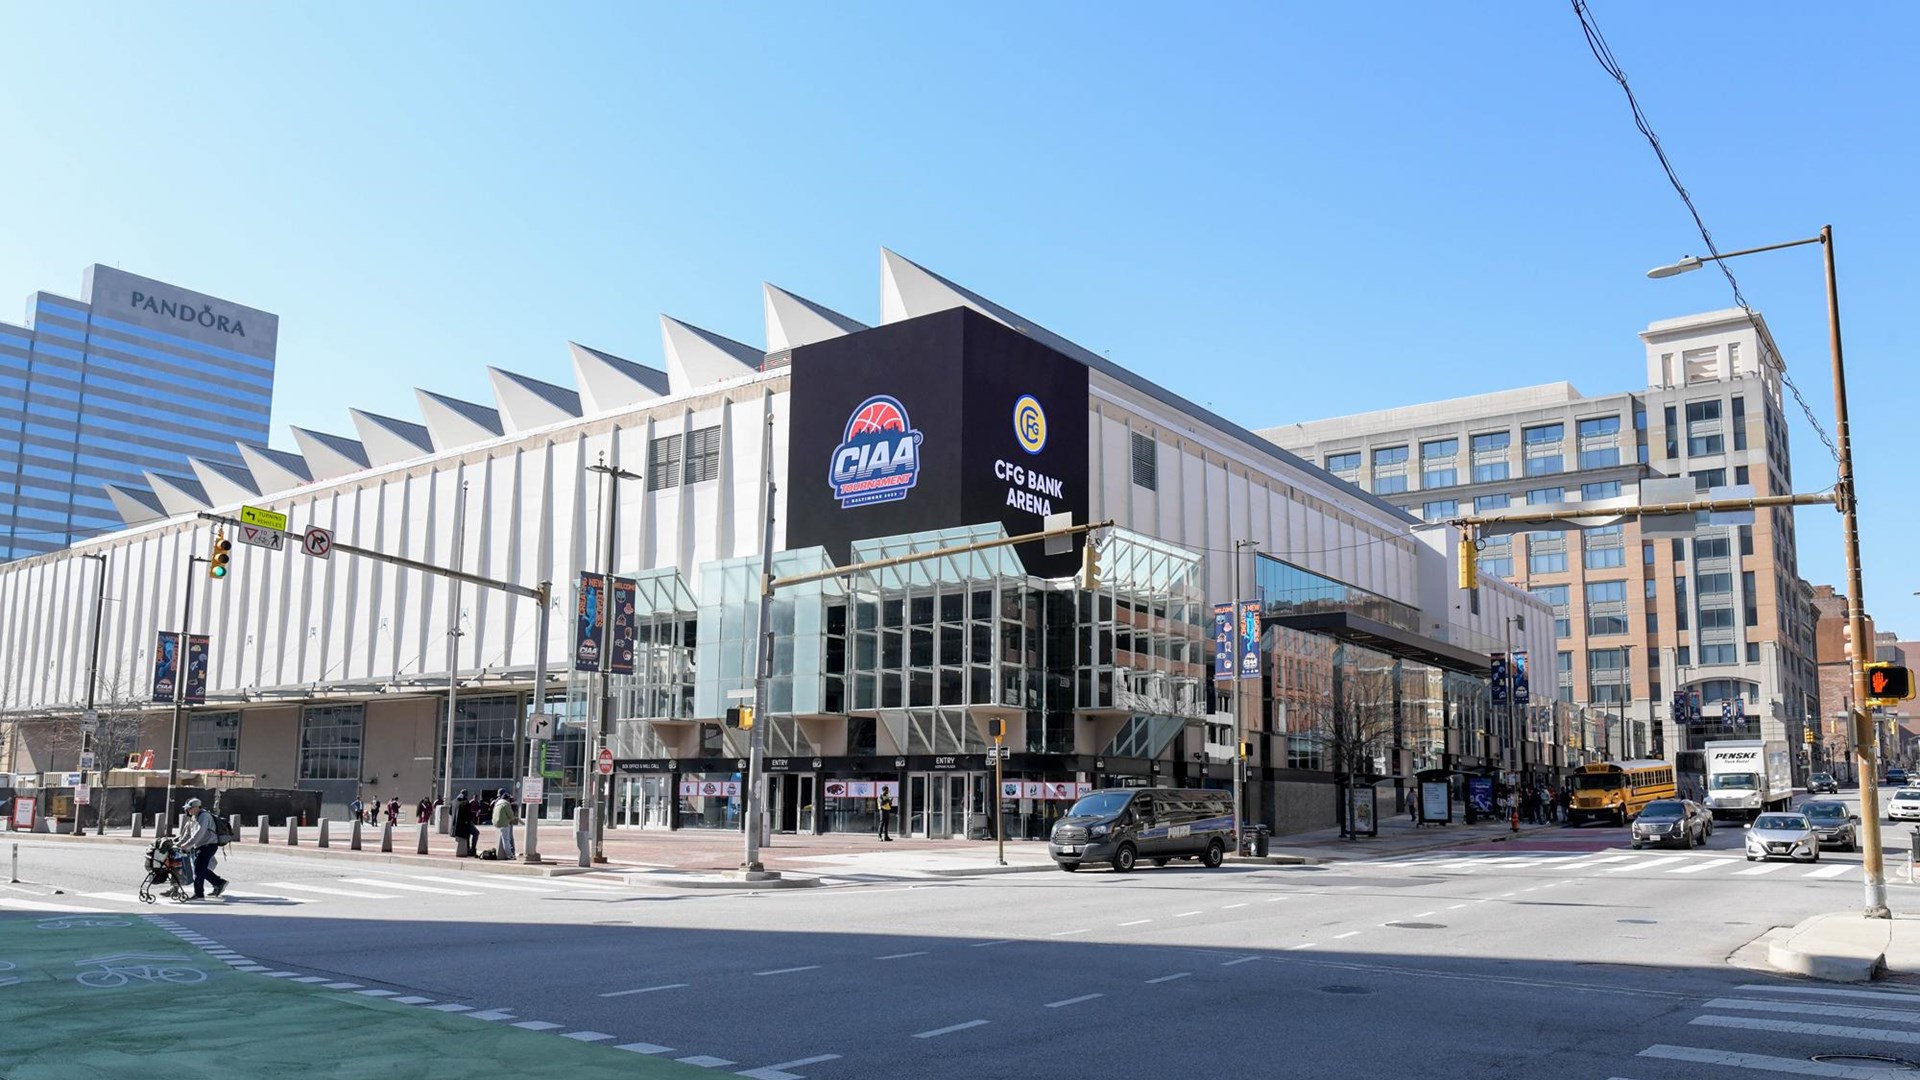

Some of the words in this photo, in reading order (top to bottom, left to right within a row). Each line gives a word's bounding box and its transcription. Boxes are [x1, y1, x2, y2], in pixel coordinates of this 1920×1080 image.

[131, 291, 245, 337] PANDORA
[834, 436, 914, 482] CIAA
[841, 473, 913, 494] TOURNAMENT
[994, 459, 1025, 486] CFG
[1028, 470, 1063, 499] BANK
[851, 494, 882, 503] BALTIMORE
[1006, 487, 1052, 517] ARENA
[259, 511, 282, 521] TURNING
[257, 519, 282, 527] VEHICLES
[589, 578, 604, 588] NEW
[580, 646, 598, 656] CIAA
[936, 756, 955, 765] ENTRY
[1715, 752, 1758, 760] PENSKE
[1167, 825, 1191, 839] POLICE
